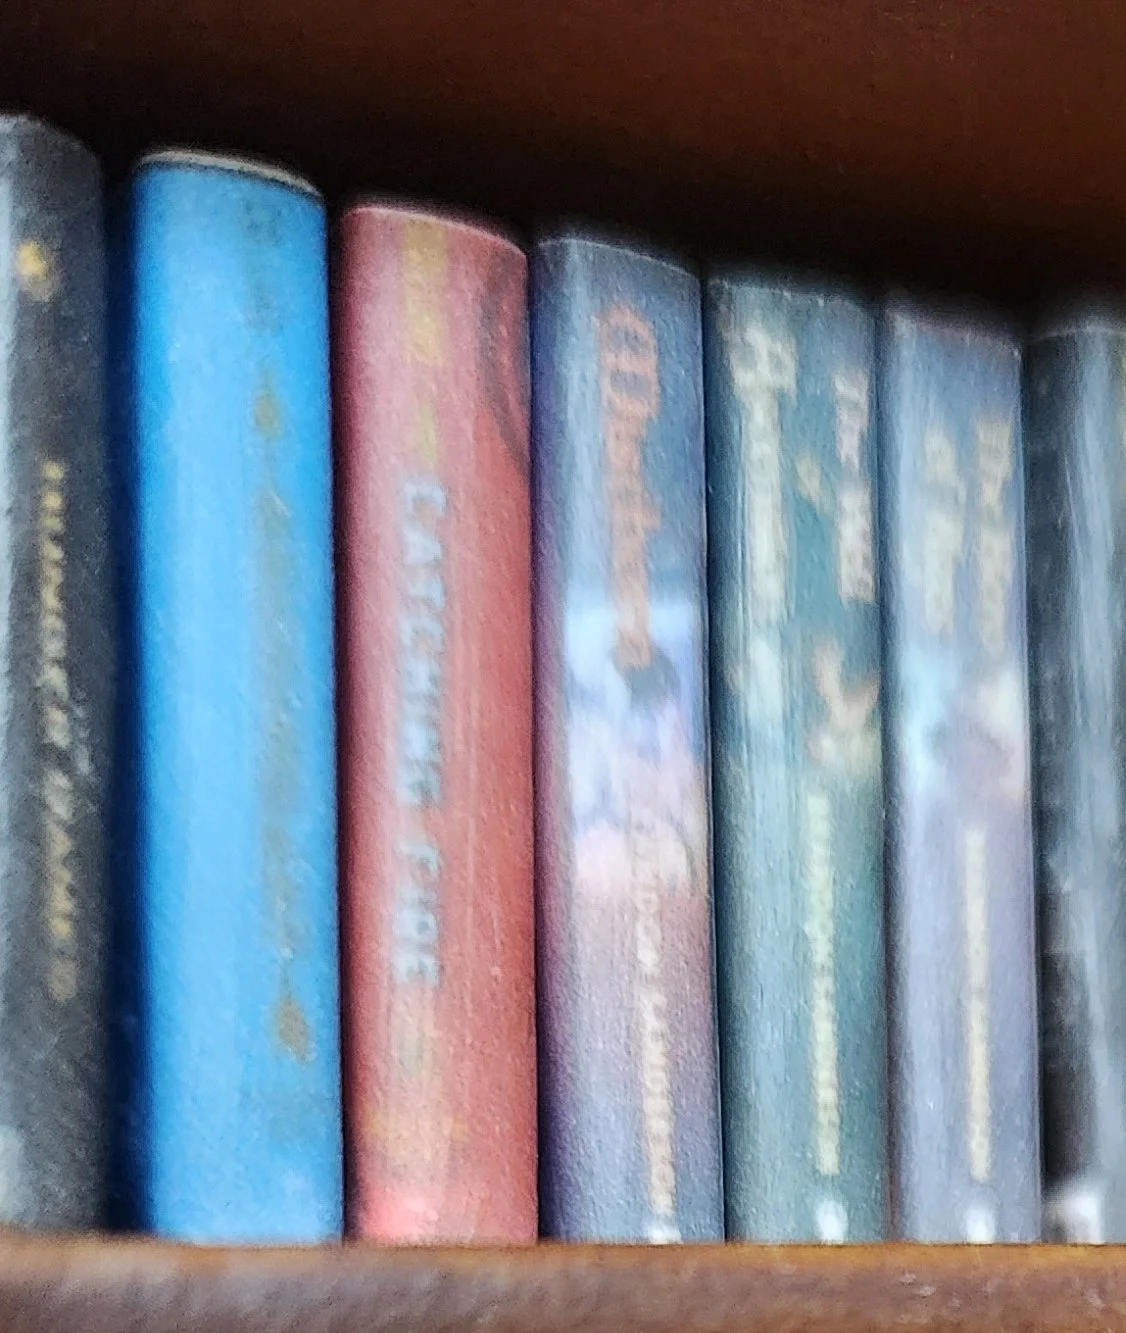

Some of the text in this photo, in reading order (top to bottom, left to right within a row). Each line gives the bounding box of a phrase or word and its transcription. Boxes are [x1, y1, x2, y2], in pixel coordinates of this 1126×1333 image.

[391, 480, 448, 988] CATCHING FIRE
[635, 990, 678, 1218] SANDERSON
